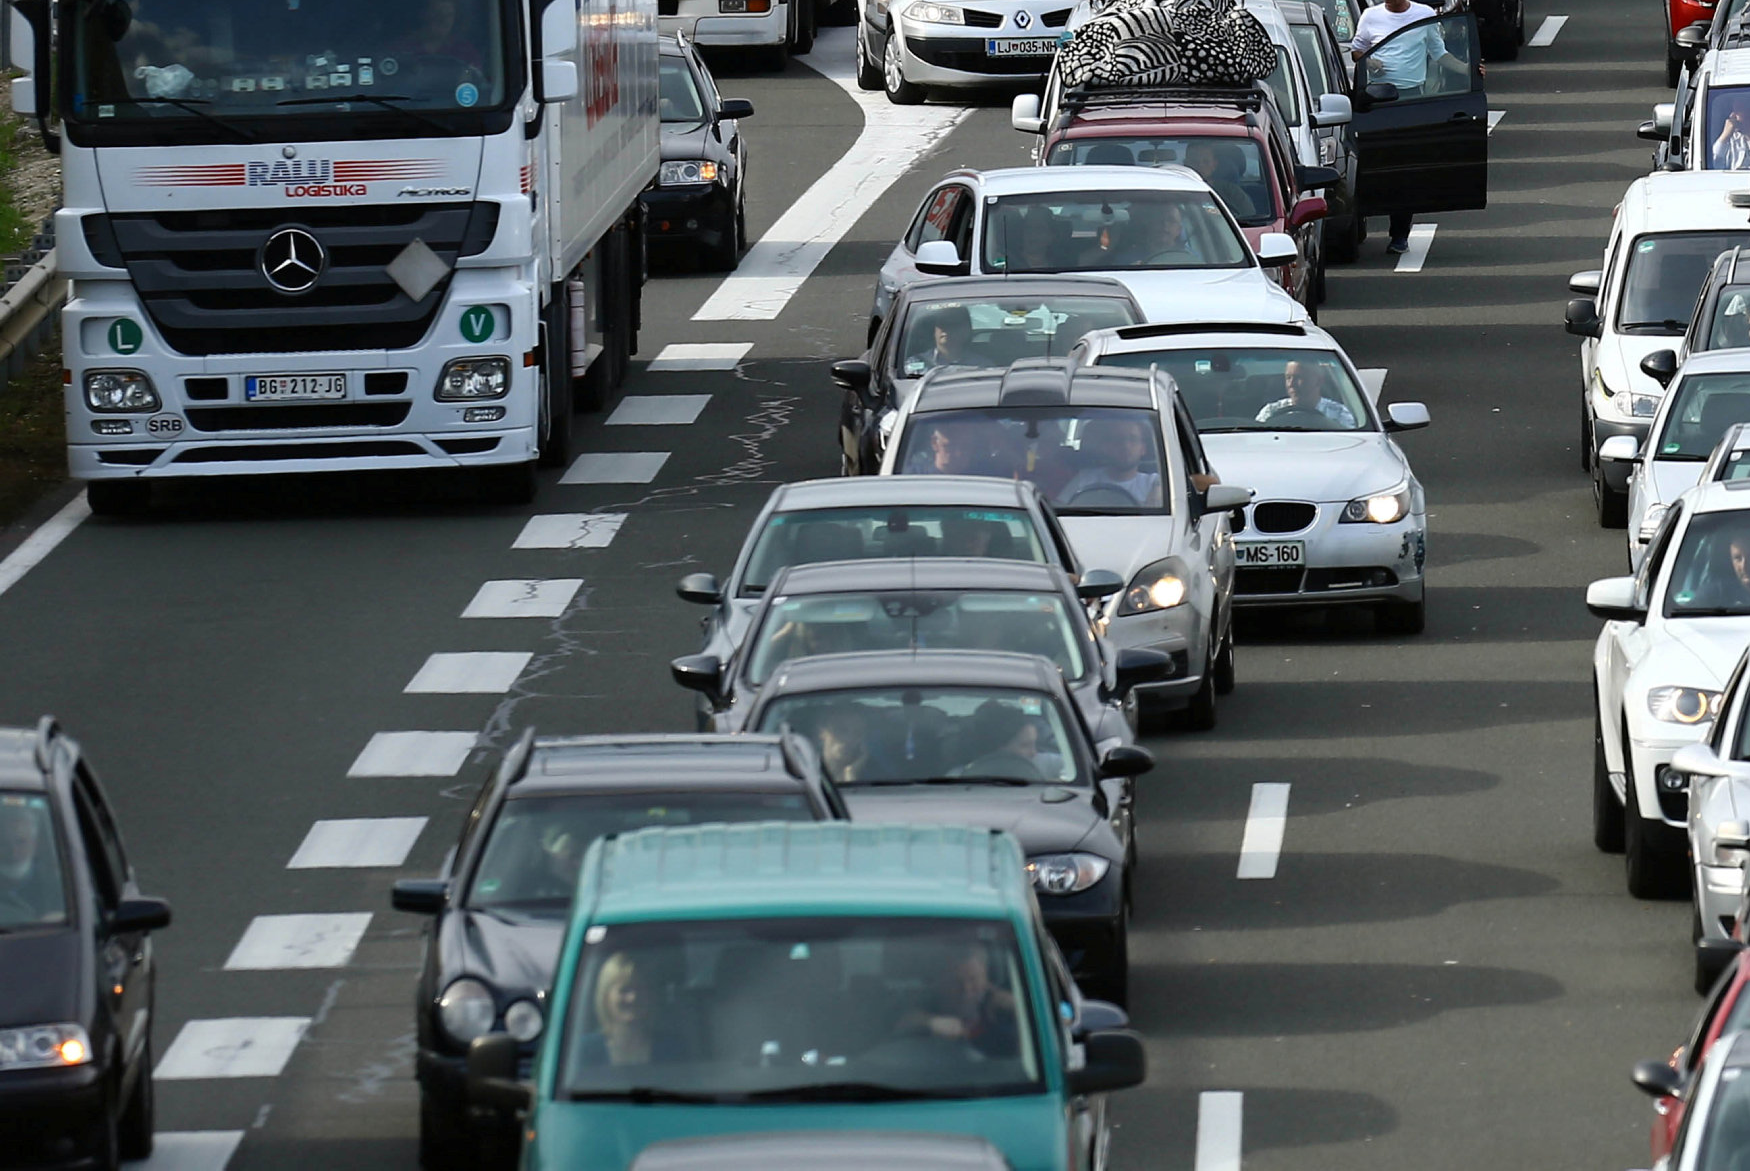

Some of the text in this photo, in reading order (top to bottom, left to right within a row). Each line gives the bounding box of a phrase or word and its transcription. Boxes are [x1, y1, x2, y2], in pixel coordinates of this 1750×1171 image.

[997, 41, 1012, 54] LJ
[470, 313, 486, 336] V
[116, 325, 134, 349] L
[258, 377, 343, 394] BG 212-JG
[149, 419, 183, 433] SRB
[1245, 545, 1300, 563] MS-160
